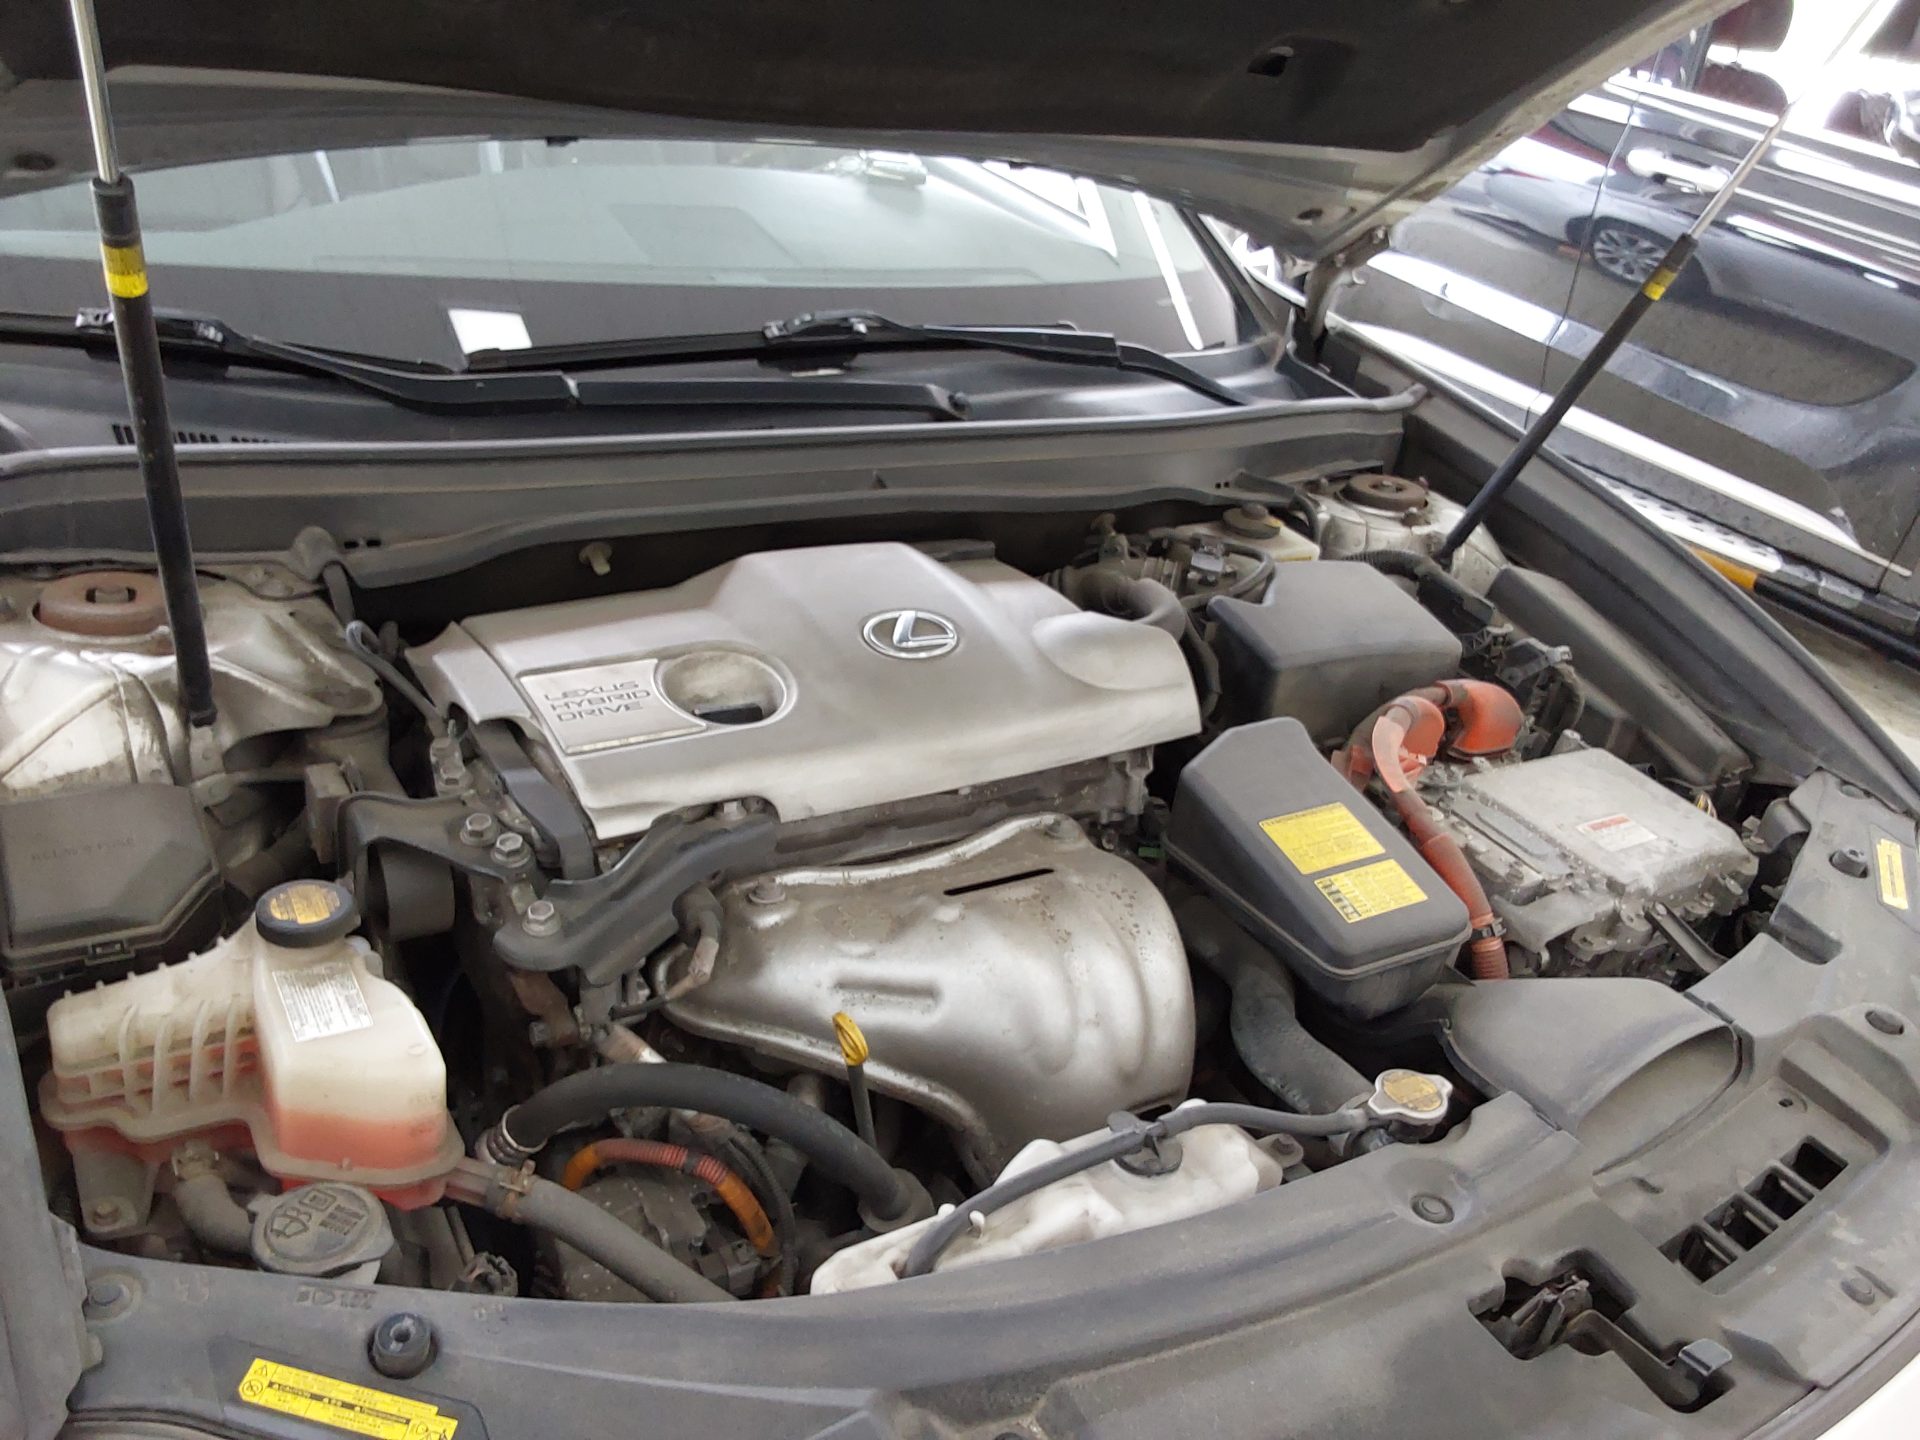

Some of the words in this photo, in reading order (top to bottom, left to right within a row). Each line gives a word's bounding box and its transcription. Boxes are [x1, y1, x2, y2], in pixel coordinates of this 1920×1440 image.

[544, 682, 639, 701] LEXUS
[550, 690, 651, 711] HYBRID
[557, 701, 643, 721] DRIVE
